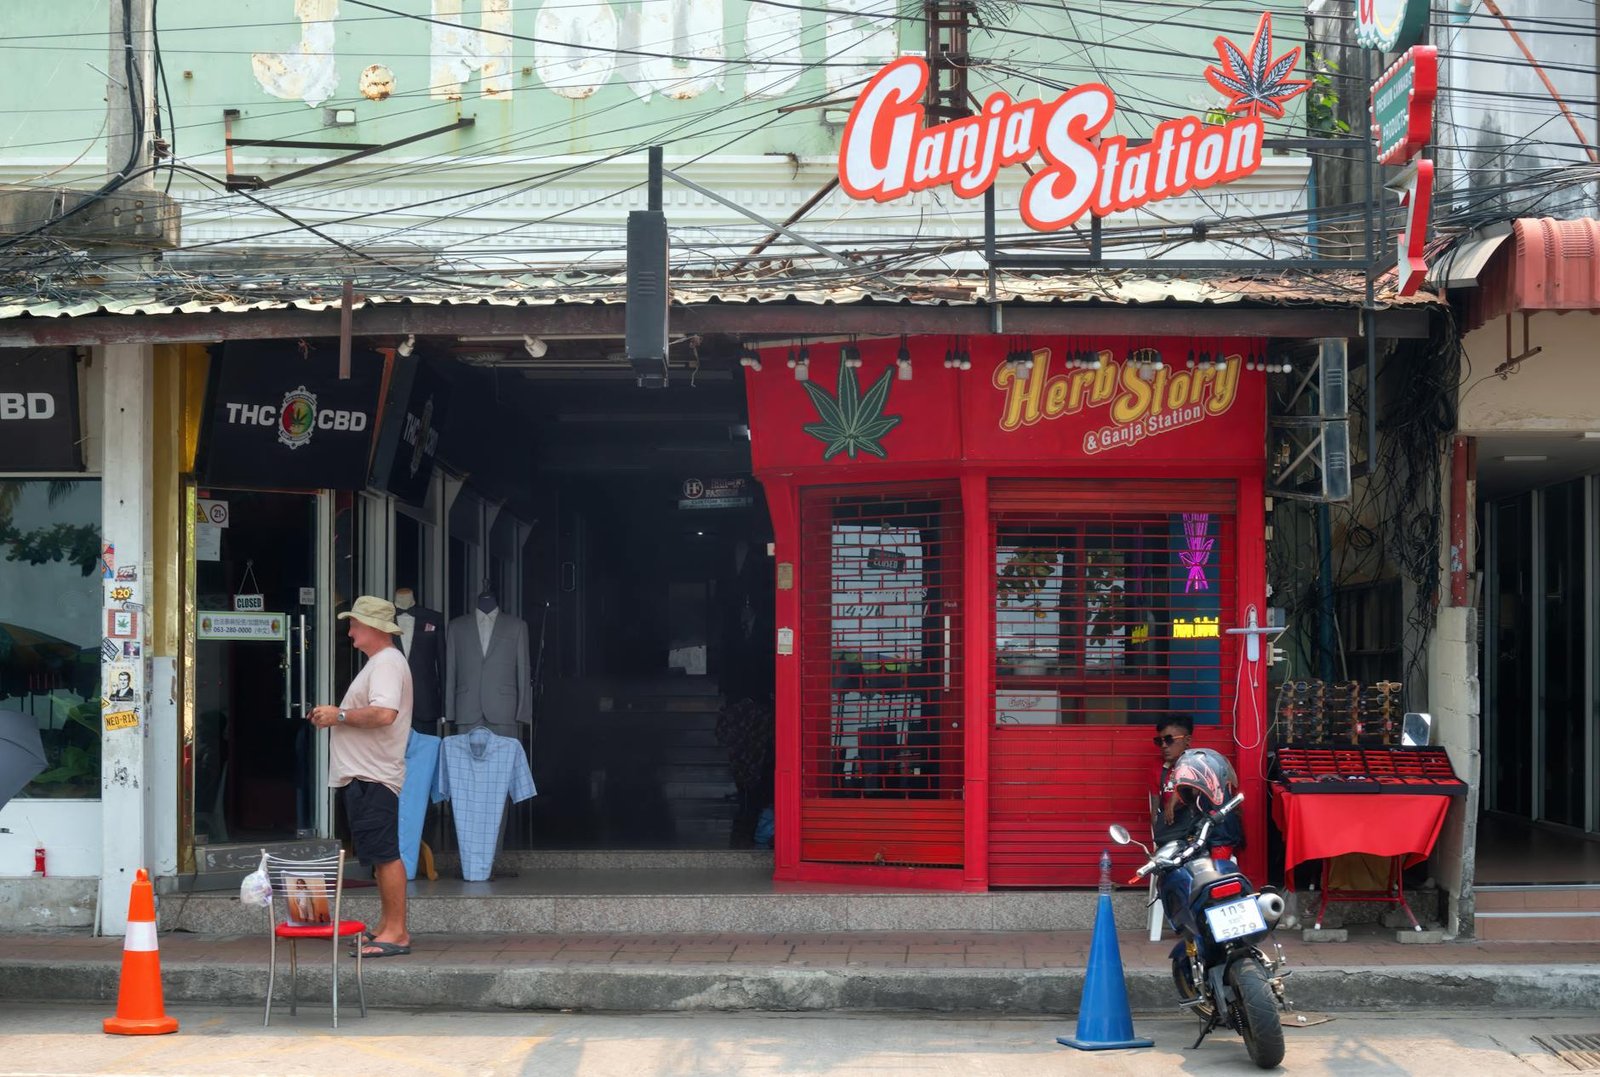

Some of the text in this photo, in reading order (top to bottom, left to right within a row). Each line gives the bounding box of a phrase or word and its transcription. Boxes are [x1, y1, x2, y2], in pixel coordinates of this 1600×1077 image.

[1382, 108, 1407, 144] PRODUCTS
[845, 62, 1258, 225] Ganja Station
[996, 349, 1241, 430] Herb Story
[226, 402, 367, 432] THC CBD
[1086, 405, 1202, 451] & Ganja Station
[111, 589, 130, 599] 420
[236, 597, 262, 609] CLOSED
[1221, 922, 1257, 938] 5279
